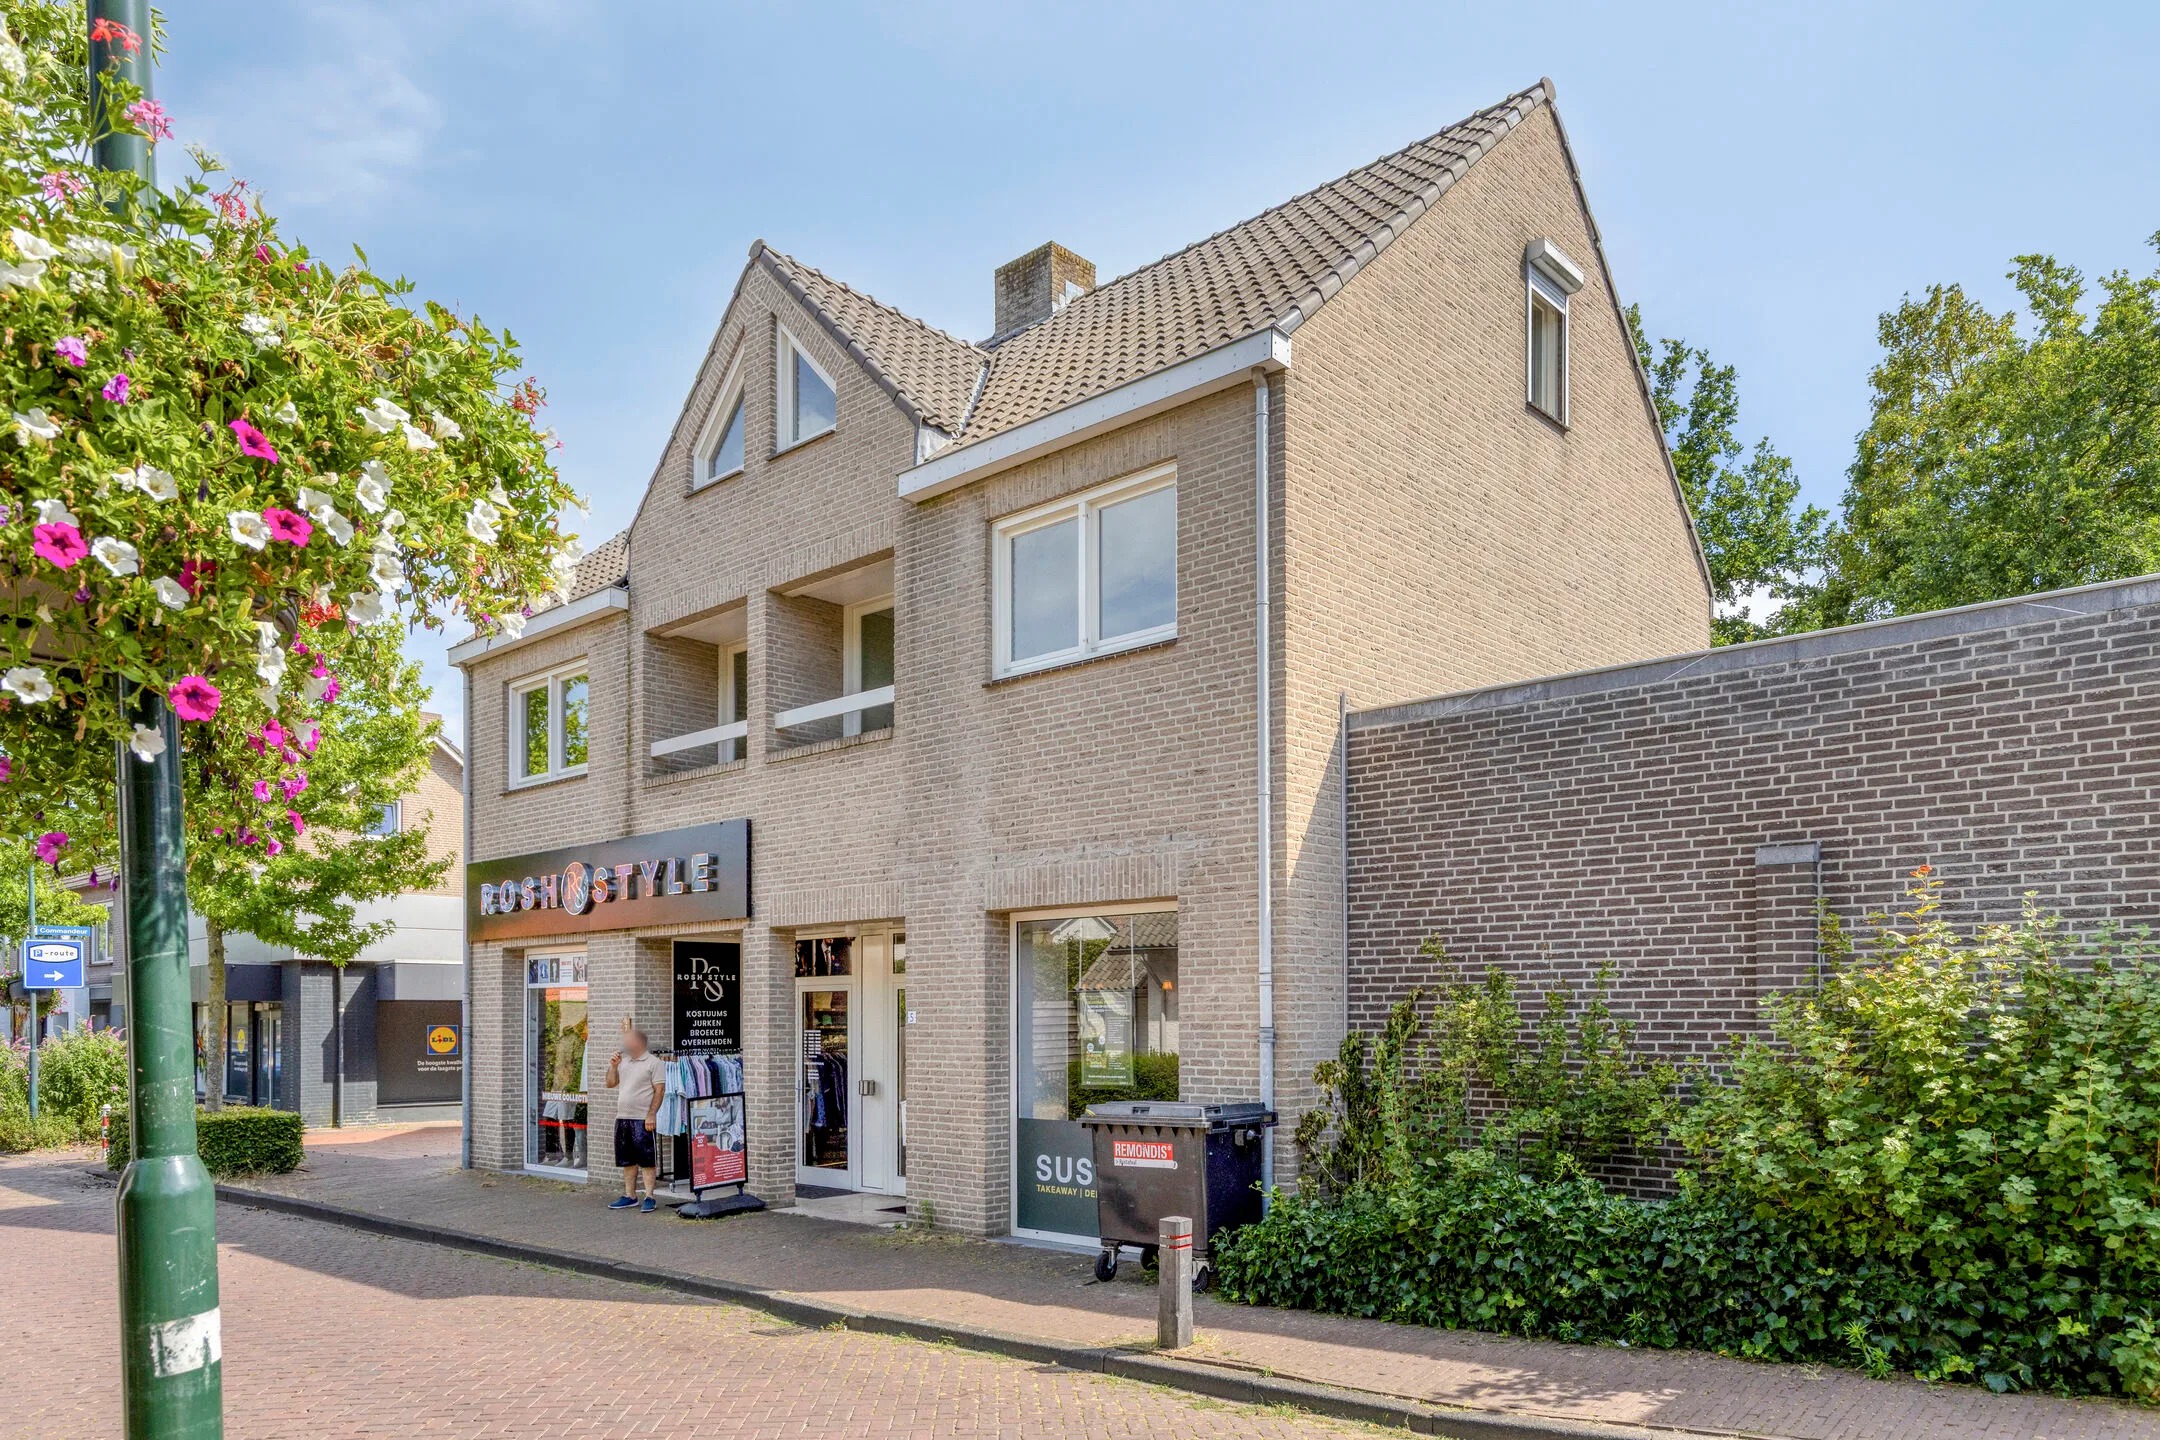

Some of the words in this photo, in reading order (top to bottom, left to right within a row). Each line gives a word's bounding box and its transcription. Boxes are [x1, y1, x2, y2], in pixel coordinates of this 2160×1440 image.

[480, 874, 558, 916] ROSH
[592, 852, 712, 904] STYLE
[40, 927, 88, 935] Commandeur
[686, 1010, 728, 1018] KOSTUUMS
[689, 1029, 724, 1037] BROEKEN
[681, 1038, 733, 1046] OVERHEMDEN
[1036, 1184, 1078, 1196] TAKEAWAY
